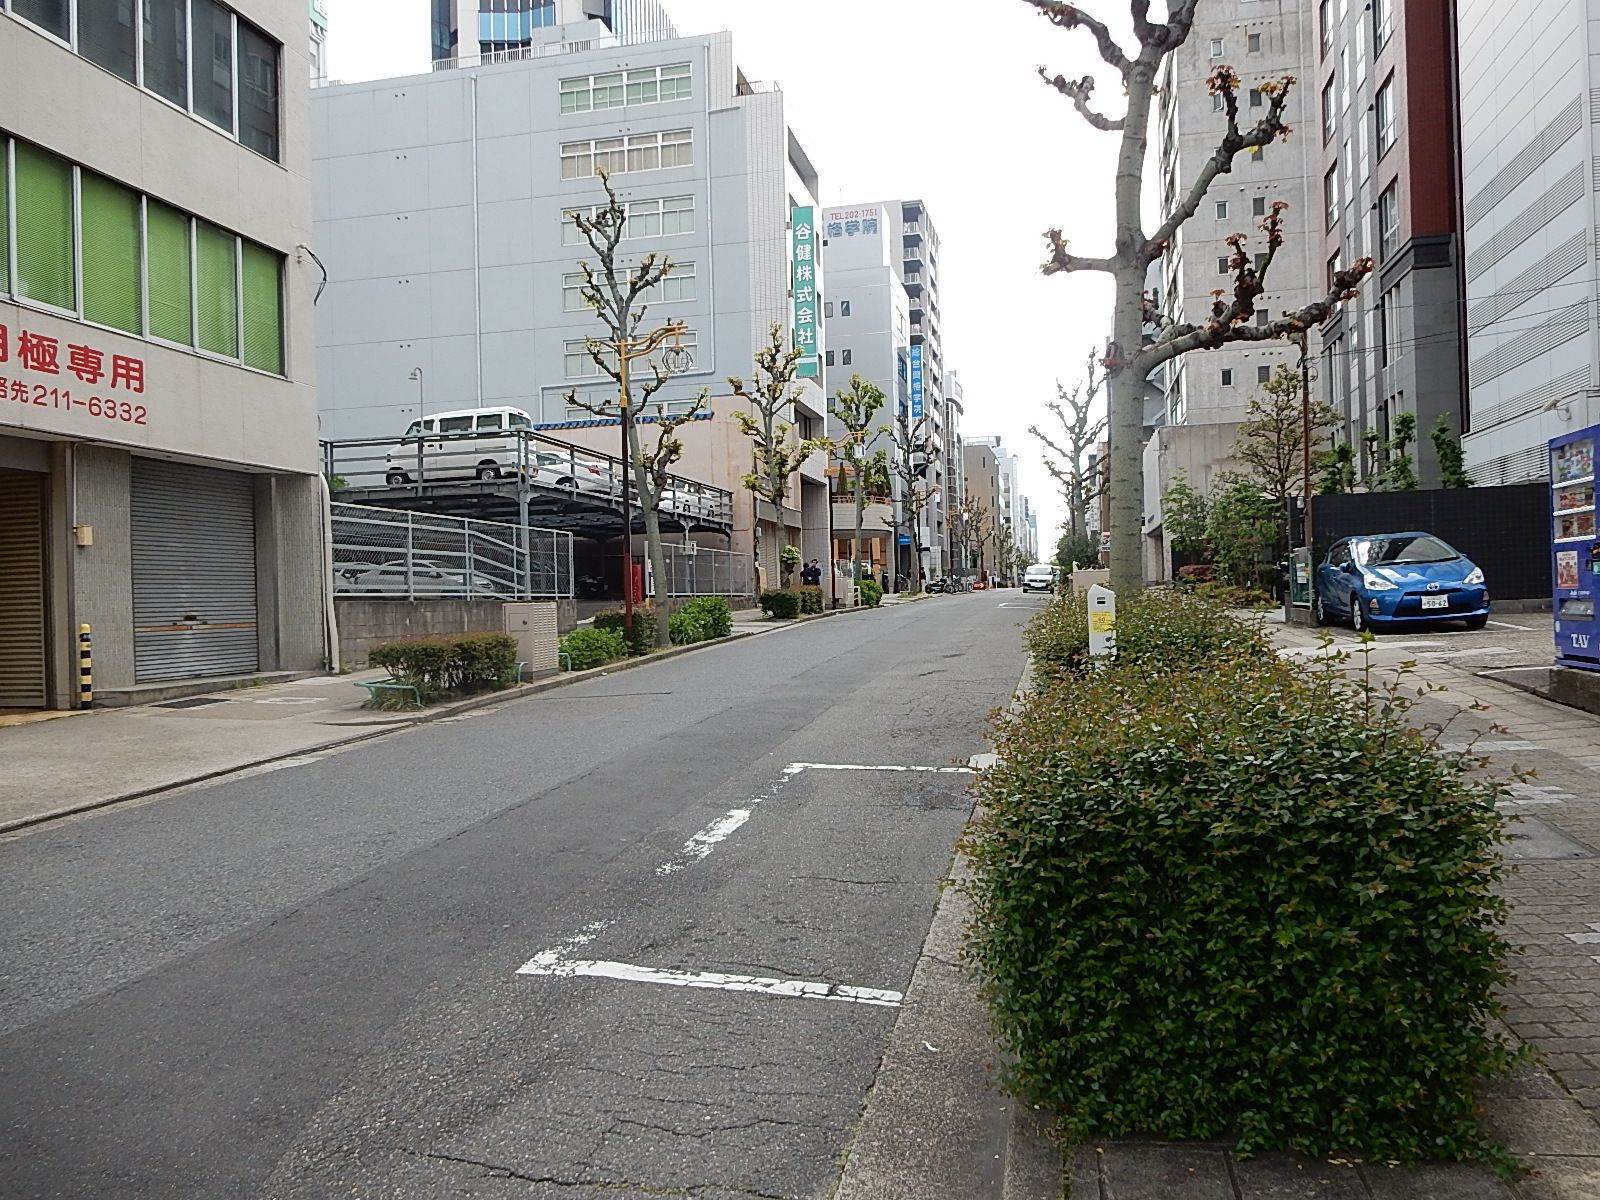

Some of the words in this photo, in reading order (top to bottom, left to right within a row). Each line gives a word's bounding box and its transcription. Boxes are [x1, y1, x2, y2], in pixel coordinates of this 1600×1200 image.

[795, 223, 814, 344] 谷健株式会社
